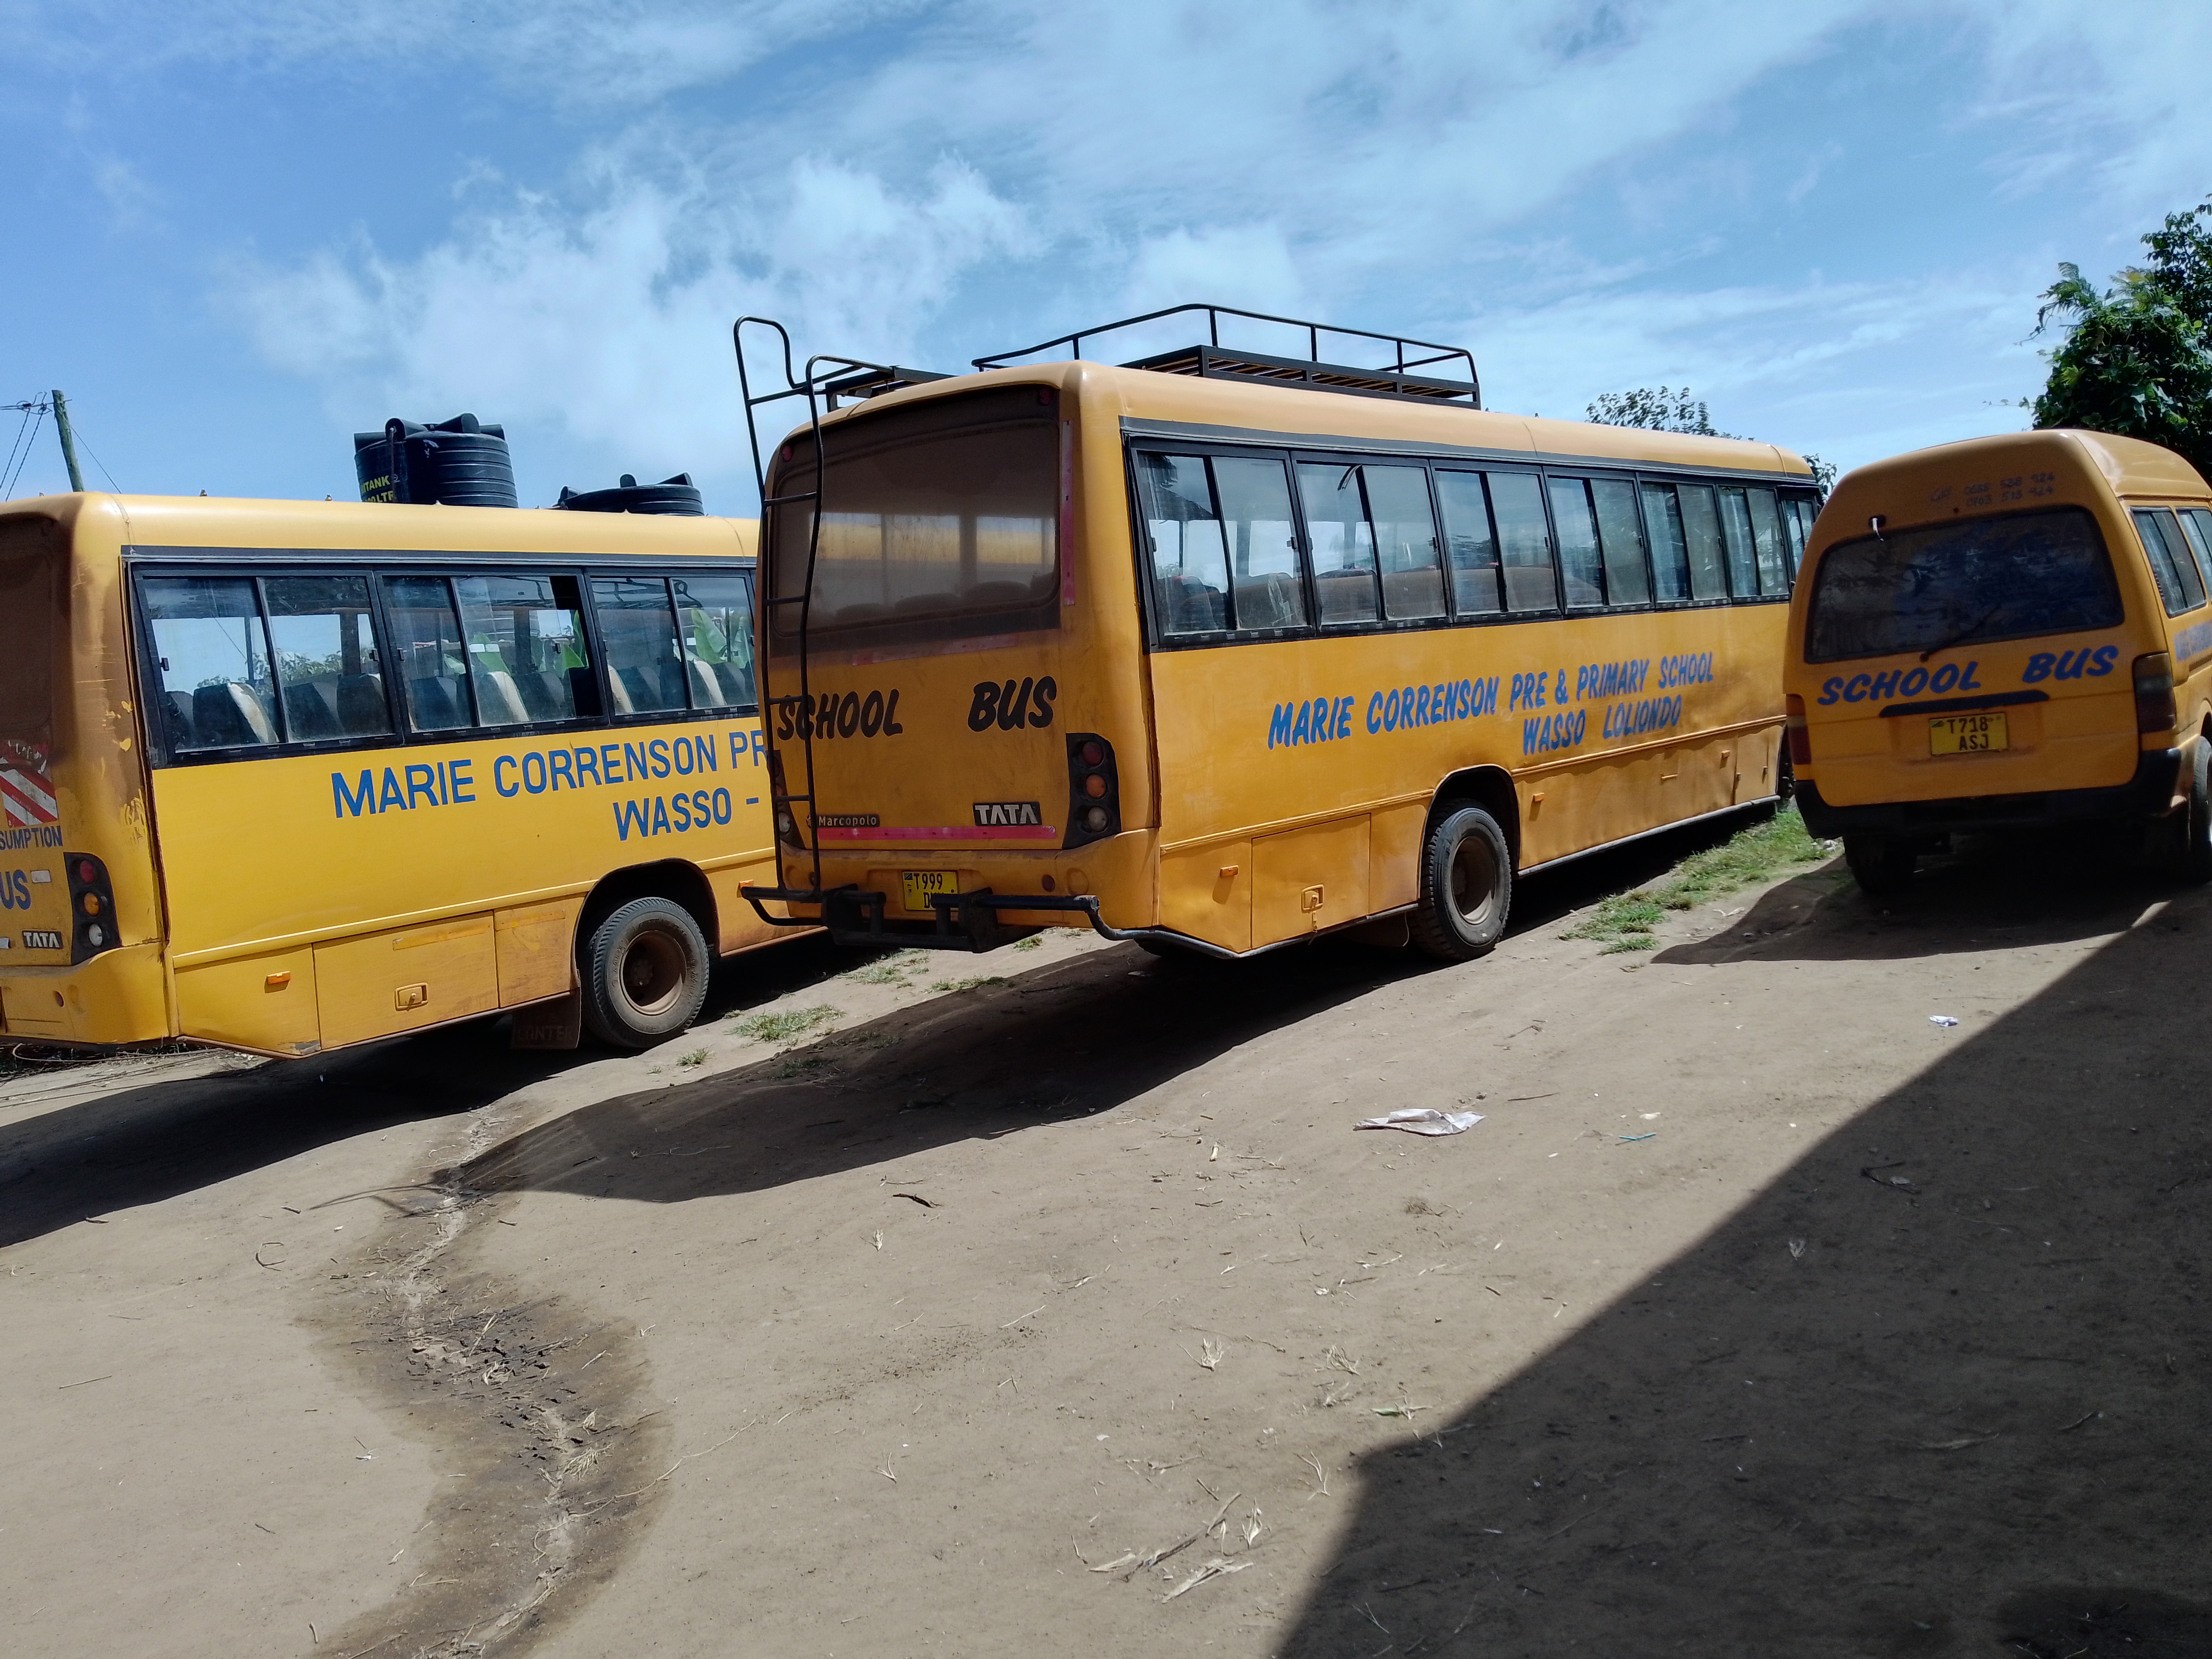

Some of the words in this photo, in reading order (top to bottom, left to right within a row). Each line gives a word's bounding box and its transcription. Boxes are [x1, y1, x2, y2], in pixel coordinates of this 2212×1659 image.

[1817, 661, 1981, 706] SCHOOL
[2022, 645, 2119, 685] BUS
[777, 688, 903, 741] SCHOOL
[967, 675, 1057, 732] BUS
[1268, 696, 1355, 751] MARIE
[1366, 676, 1500, 734] CORRENSON
[1510, 672, 1548, 712] PRE
[1554, 668, 1569, 705] &
[1576, 658, 1650, 701] PRIMARY
[1659, 651, 1714, 689] SCHOOL
[1523, 709, 1587, 756] WASSO
[1603, 694, 1683, 737] LOLIONDO
[1947, 716, 1988, 734] T718
[1959, 733, 1989, 751] ASJ
[331, 758, 477, 818] MARIE
[493, 734, 718, 798] CORRENSON
[612, 787, 732, 842] WASSO
[818, 815, 877, 827] Marcopolo
[974, 804, 1038, 825] TATA
[913, 873, 943, 890] T999
[23, 932, 60, 949] TATA
